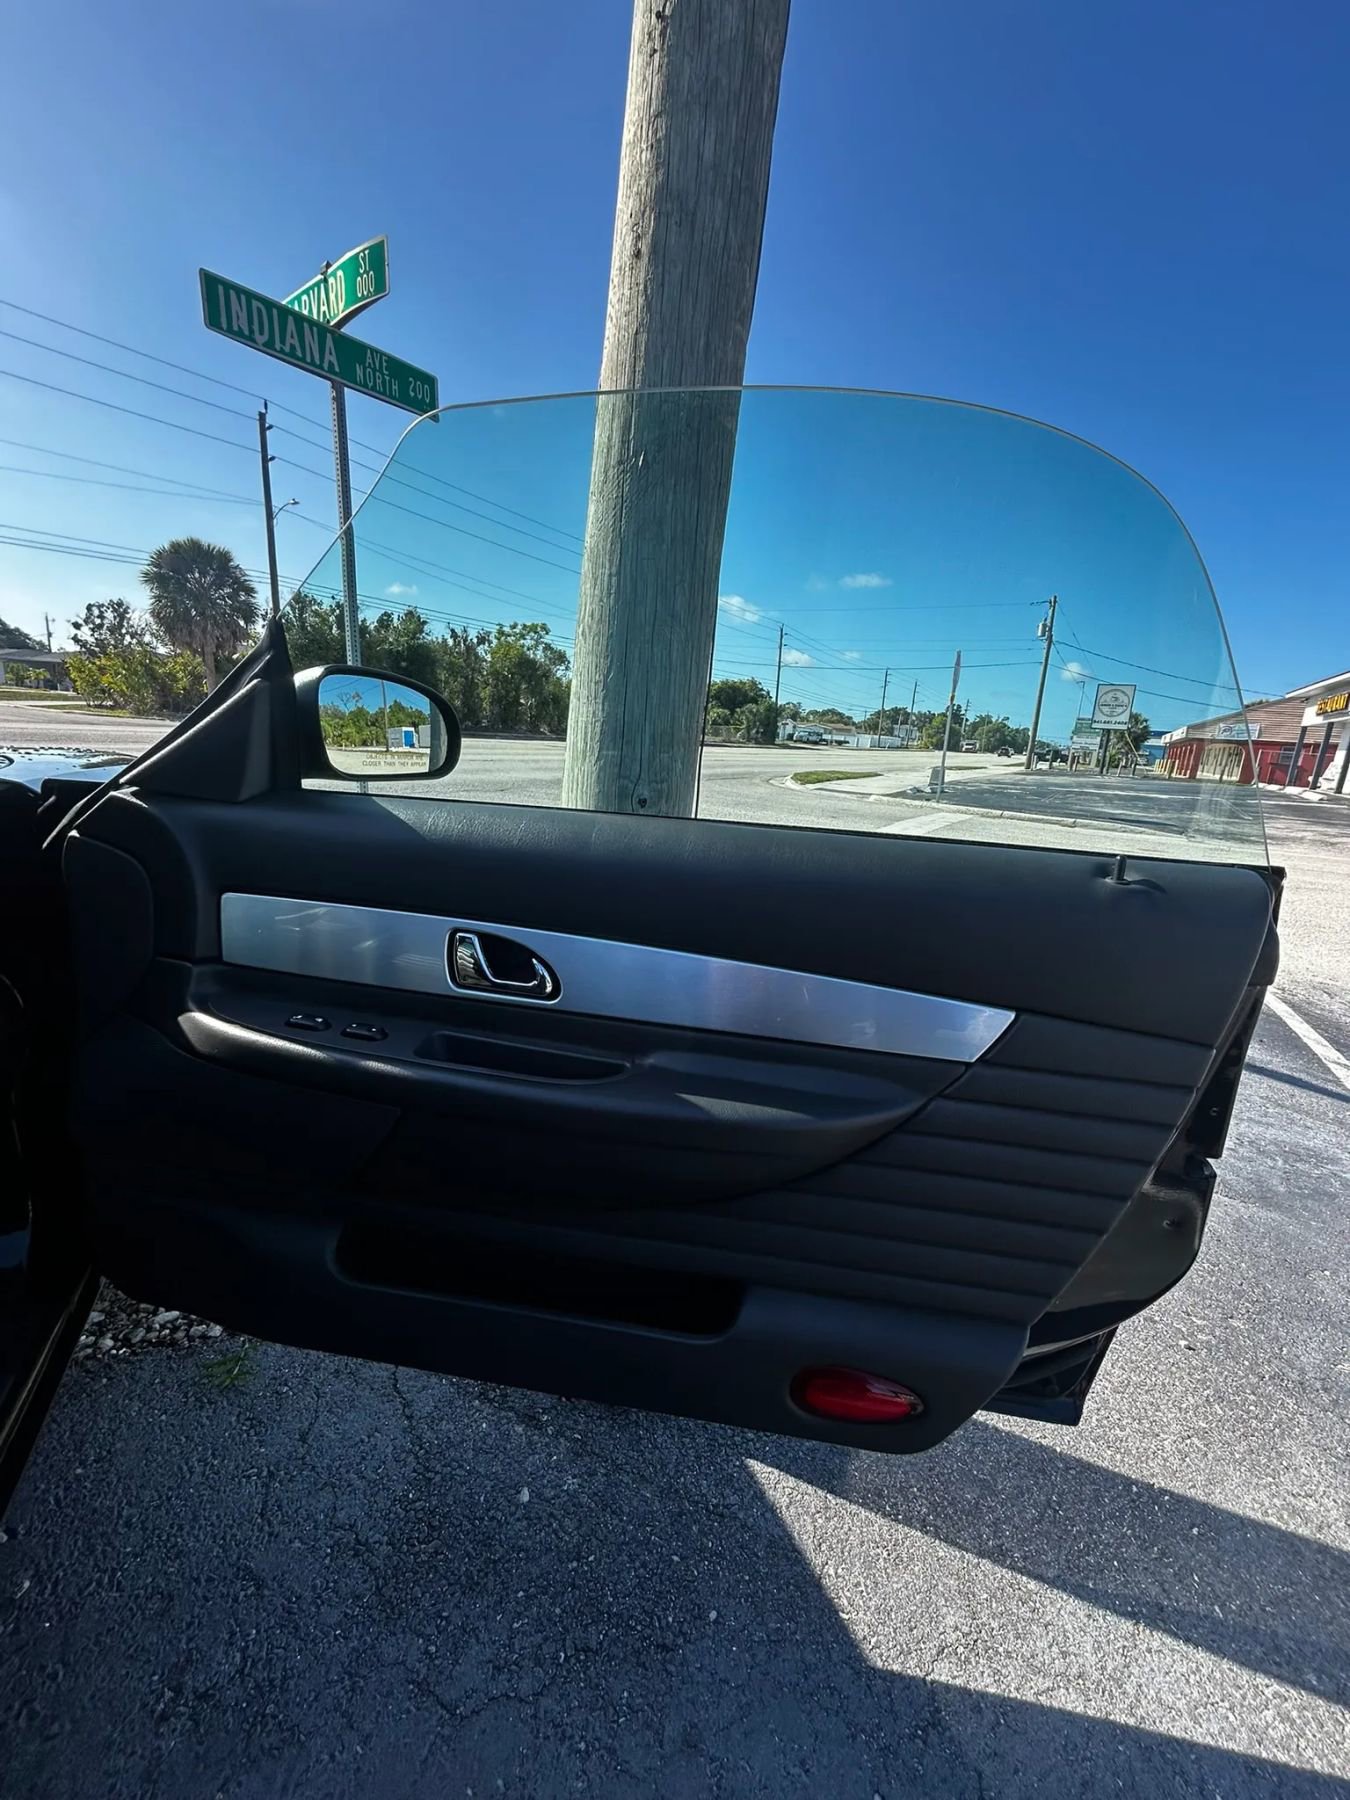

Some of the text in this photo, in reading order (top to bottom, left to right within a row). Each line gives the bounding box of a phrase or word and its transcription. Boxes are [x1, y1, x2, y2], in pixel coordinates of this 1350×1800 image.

[288, 249, 370, 322] RVARD ST
[356, 270, 375, 298] 000
[217, 284, 389, 374] INDIANA AVE
[356, 362, 431, 403] NORTH 200
